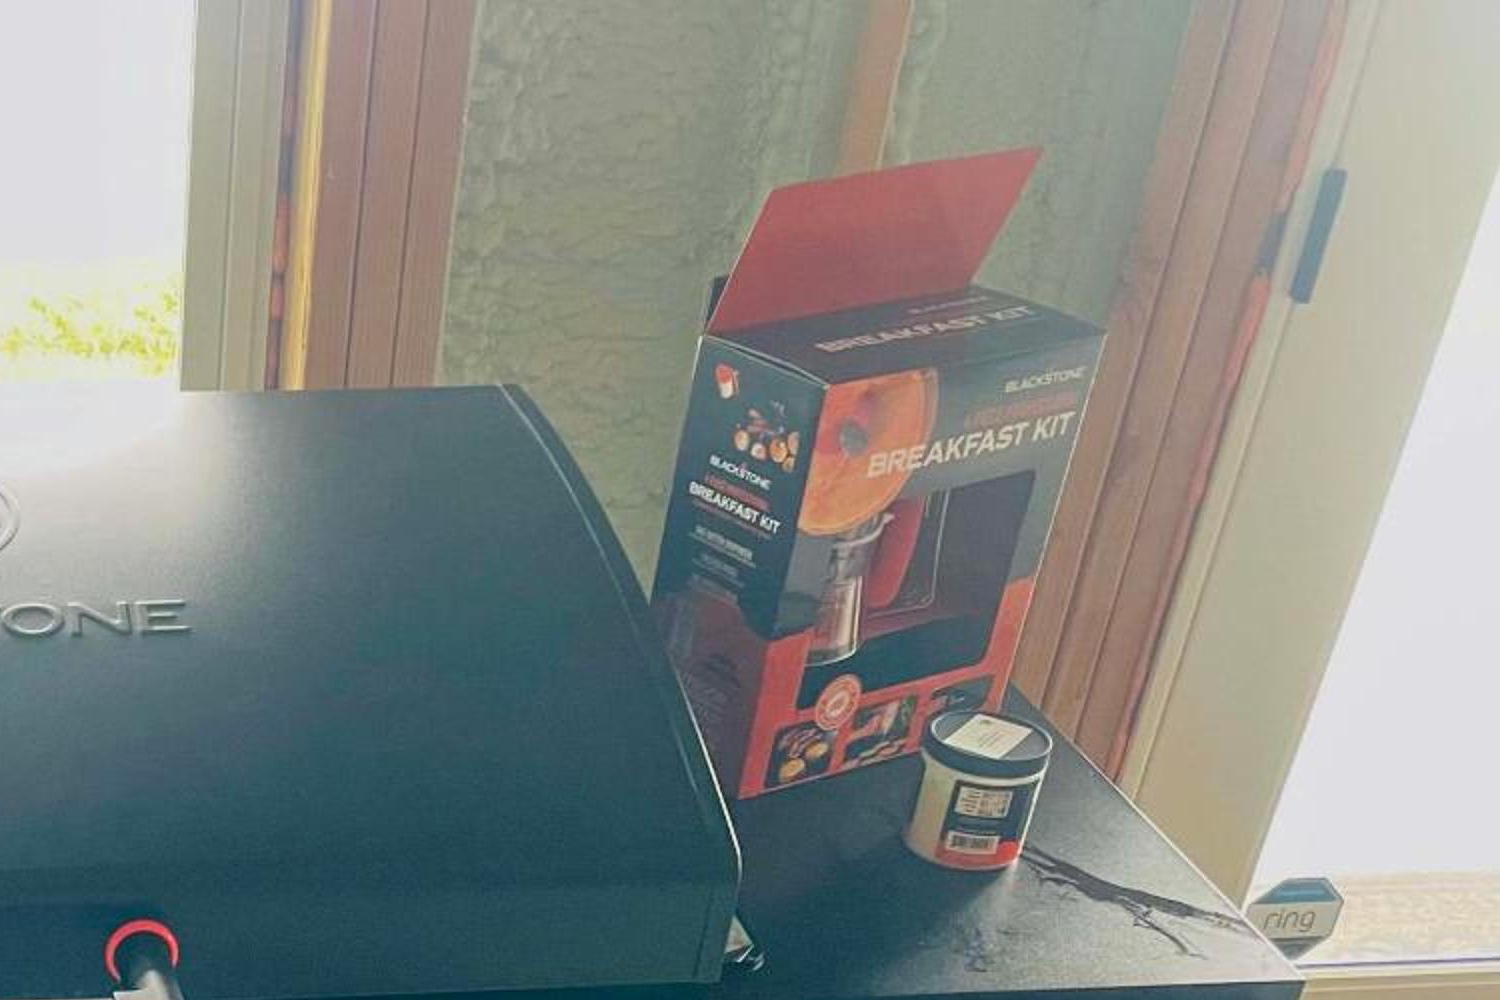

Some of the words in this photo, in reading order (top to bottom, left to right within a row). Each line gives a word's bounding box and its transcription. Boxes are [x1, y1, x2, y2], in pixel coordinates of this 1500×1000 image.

[815, 316, 987, 353] BREAKFAST
[985, 305, 1034, 322] KIT
[1004, 366, 1087, 393] BLACKSTONE
[866, 421, 1030, 478] BREAKFAST
[1031, 411, 1077, 442] KIT
[709, 454, 772, 491] BLACKSTONE
[689, 481, 760, 524] BREAKFAST
[759, 513, 781, 535] KIT
[1263, 908, 1317, 933] ring
